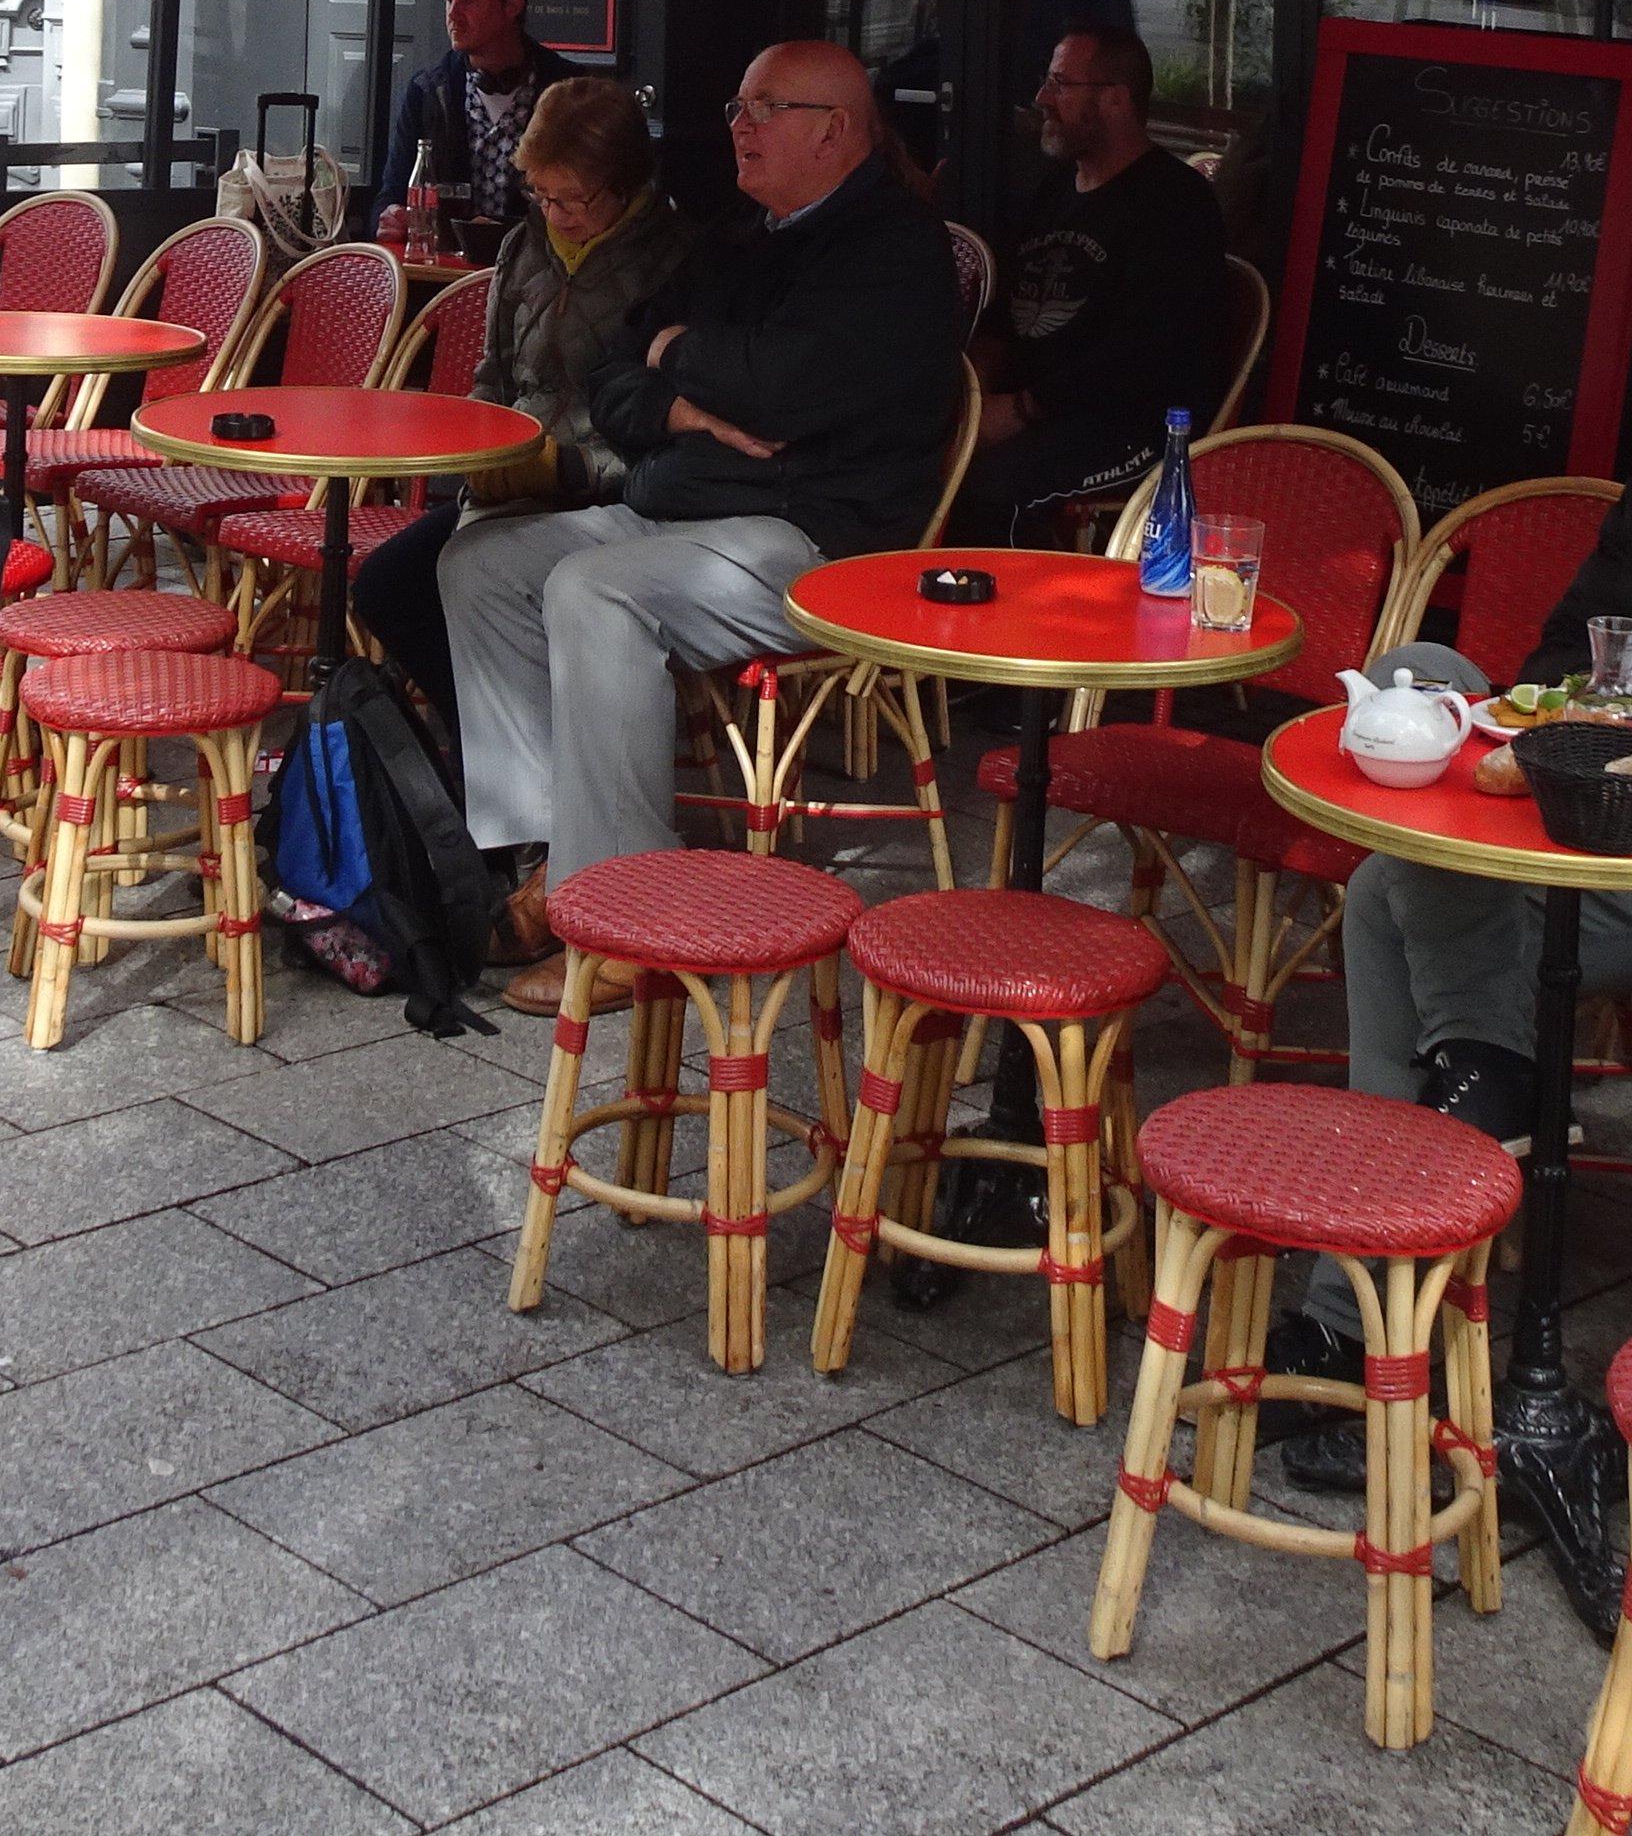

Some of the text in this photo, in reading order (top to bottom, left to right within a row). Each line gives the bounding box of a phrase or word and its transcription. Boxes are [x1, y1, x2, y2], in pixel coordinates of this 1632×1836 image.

[1436, 154, 1459, 174] de
[1355, 169, 1372, 184] de
[1503, 224, 1522, 241] de
